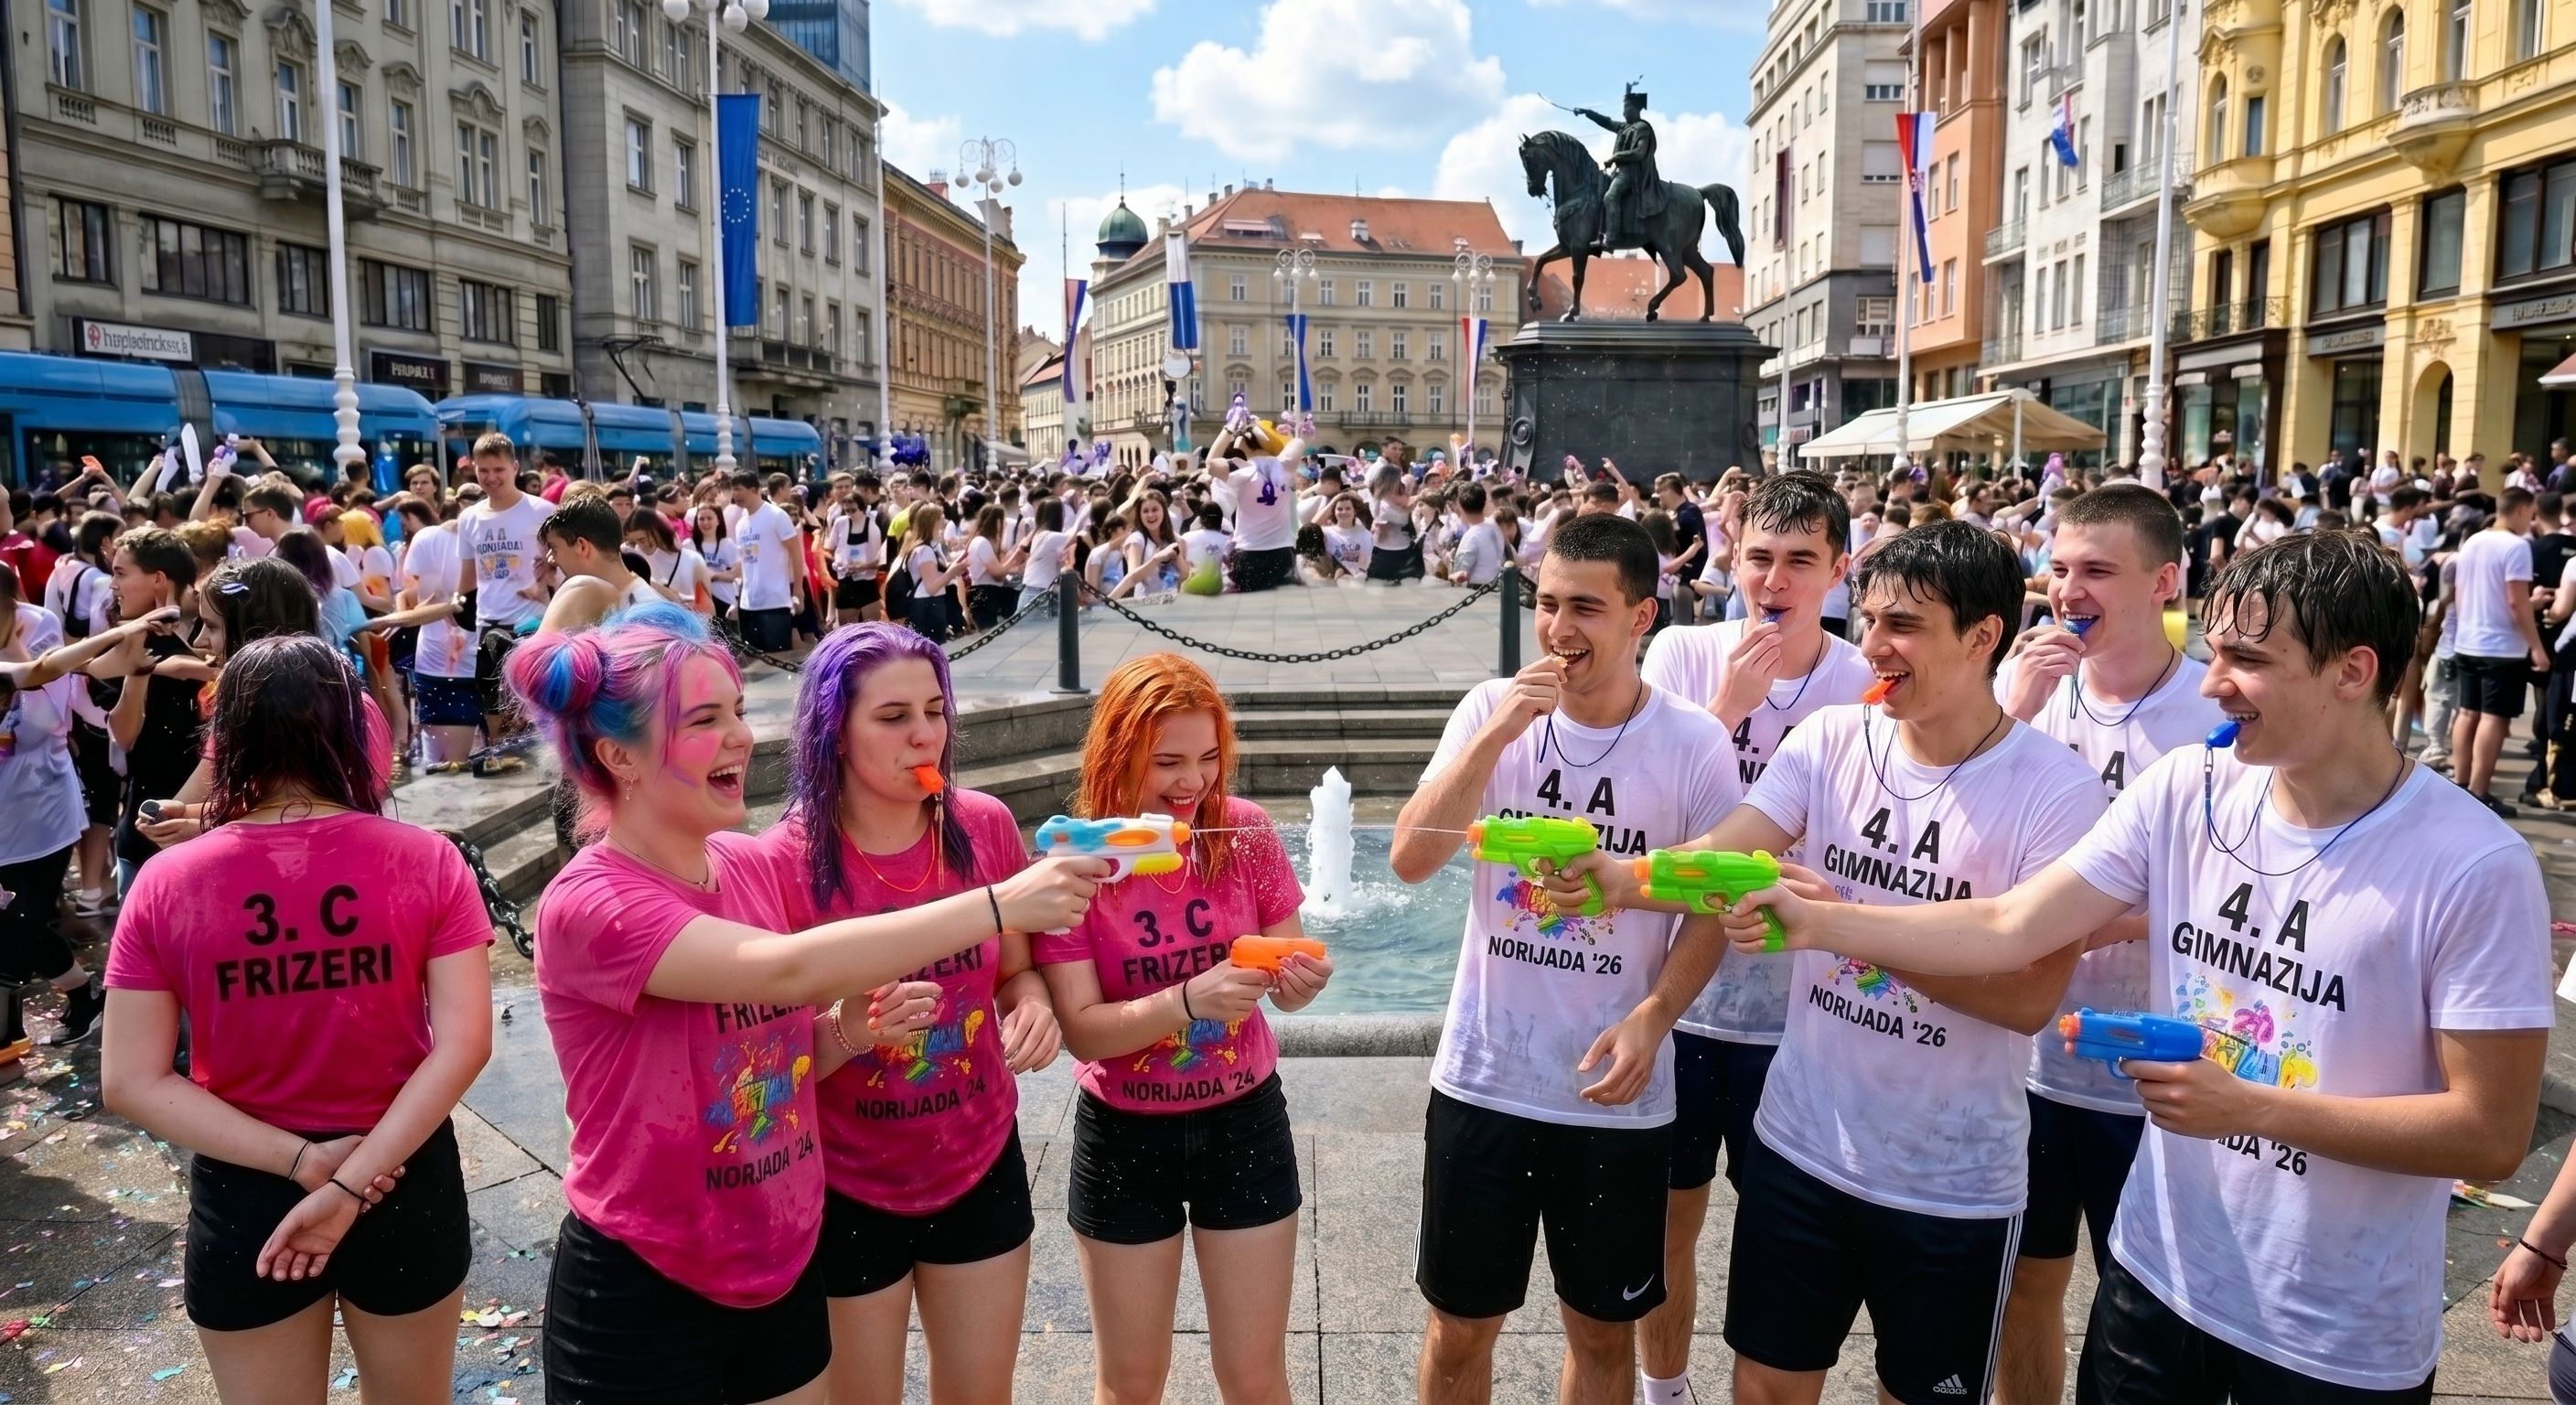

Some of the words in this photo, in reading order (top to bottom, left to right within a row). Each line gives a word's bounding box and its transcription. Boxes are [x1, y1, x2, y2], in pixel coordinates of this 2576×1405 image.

[1732, 716, 1759, 755] 4.
[1537, 768, 1572, 810] 4.
[1585, 777, 1615, 816] A
[2101, 750, 2125, 790] A
[1861, 807, 1898, 854] 4.
[1912, 820, 1940, 864] A
[1824, 843, 1972, 902] GIMNAZIJA
[242, 893, 298, 946] 3.
[320, 885, 360, 937] C
[1133, 910, 1175, 948] 3.
[1186, 898, 1214, 938] C
[2217, 883, 2261, 938] 4.
[2275, 899, 2310, 953] A
[215, 943, 393, 1003] FRIZERI
[1123, 937, 1236, 987] FRIZER
[1487, 936, 1585, 972] NORIJADA
[1593, 954, 1623, 975] '26
[2172, 920, 2346, 1012] GIMNAZIJA
[1809, 983, 1904, 1040] NORIJADA
[1913, 1021, 1948, 1048] '26
[854, 1089, 961, 1121] NORIJADA
[1122, 1078, 1225, 1103] NORIJADA
[1229, 1067, 1256, 1091] '24
[795, 1130, 814, 1161] '24
[2270, 1141, 2308, 1176] '26
